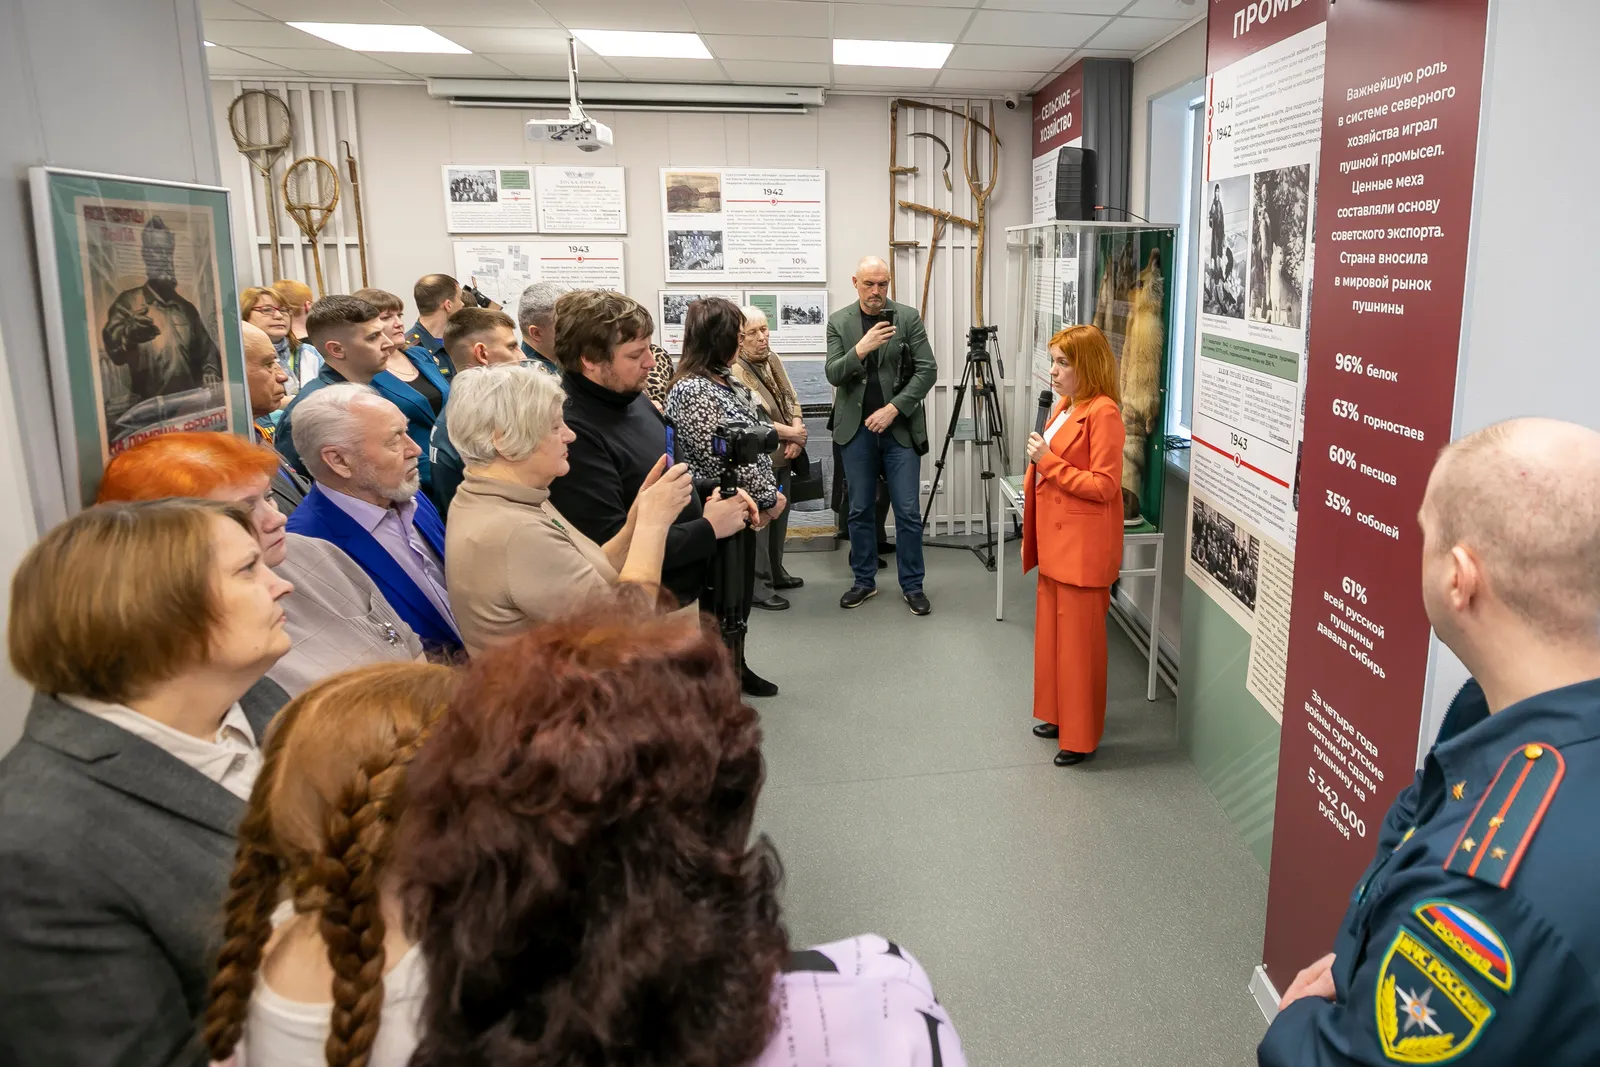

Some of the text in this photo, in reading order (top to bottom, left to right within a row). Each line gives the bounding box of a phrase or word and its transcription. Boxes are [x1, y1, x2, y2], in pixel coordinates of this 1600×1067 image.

[1347, 61, 1447, 101] Важнейшую роль
[1041, 89, 1071, 120] СЕЛЬСКОЕ
[1217, 97, 1233, 114] 1941
[1338, 85, 1456, 126] в системе северного
[1040, 112, 1072, 143] ХОЗЯЙСТВО
[1216, 125, 1232, 141] 1942
[1347, 117, 1438, 148] хозяйства играл
[1339, 143, 1445, 173] пушной промысел.
[763, 188, 783, 196] 1942
[1352, 173, 1424, 195] Ценные меха
[1337, 198, 1440, 218] составляли основу
[568, 245, 589, 253] 1943
[1331, 225, 1445, 242] советского экспорта.
[1340, 251, 1429, 266] Страна вносила
[1335, 274, 1432, 292] в мировой рынок
[1352, 299, 1404, 315] пушнины
[1335, 352, 1398, 383] 96% белок
[1332, 398, 1425, 442] 63% горностаев
[1230, 432, 1248, 450] 1943
[1329, 445, 1397, 486] 60% песцов
[1325, 489, 1400, 540] 35% соболей
[1342, 576, 1368, 605] 61%
[1323, 591, 1385, 639] всей русской
[1330, 613, 1374, 651] пушнины
[1317, 622, 1386, 679] давала Сибирь
[1311, 689, 1379, 757] За четыре года
[1304, 701, 1385, 782] войны сургутские
[1307, 721, 1377, 794] охотники сдали
[1313, 744, 1366, 802] пушнину на
[1307, 766, 1366, 838] 5 342 000
[1318, 801, 1351, 840] рублей
